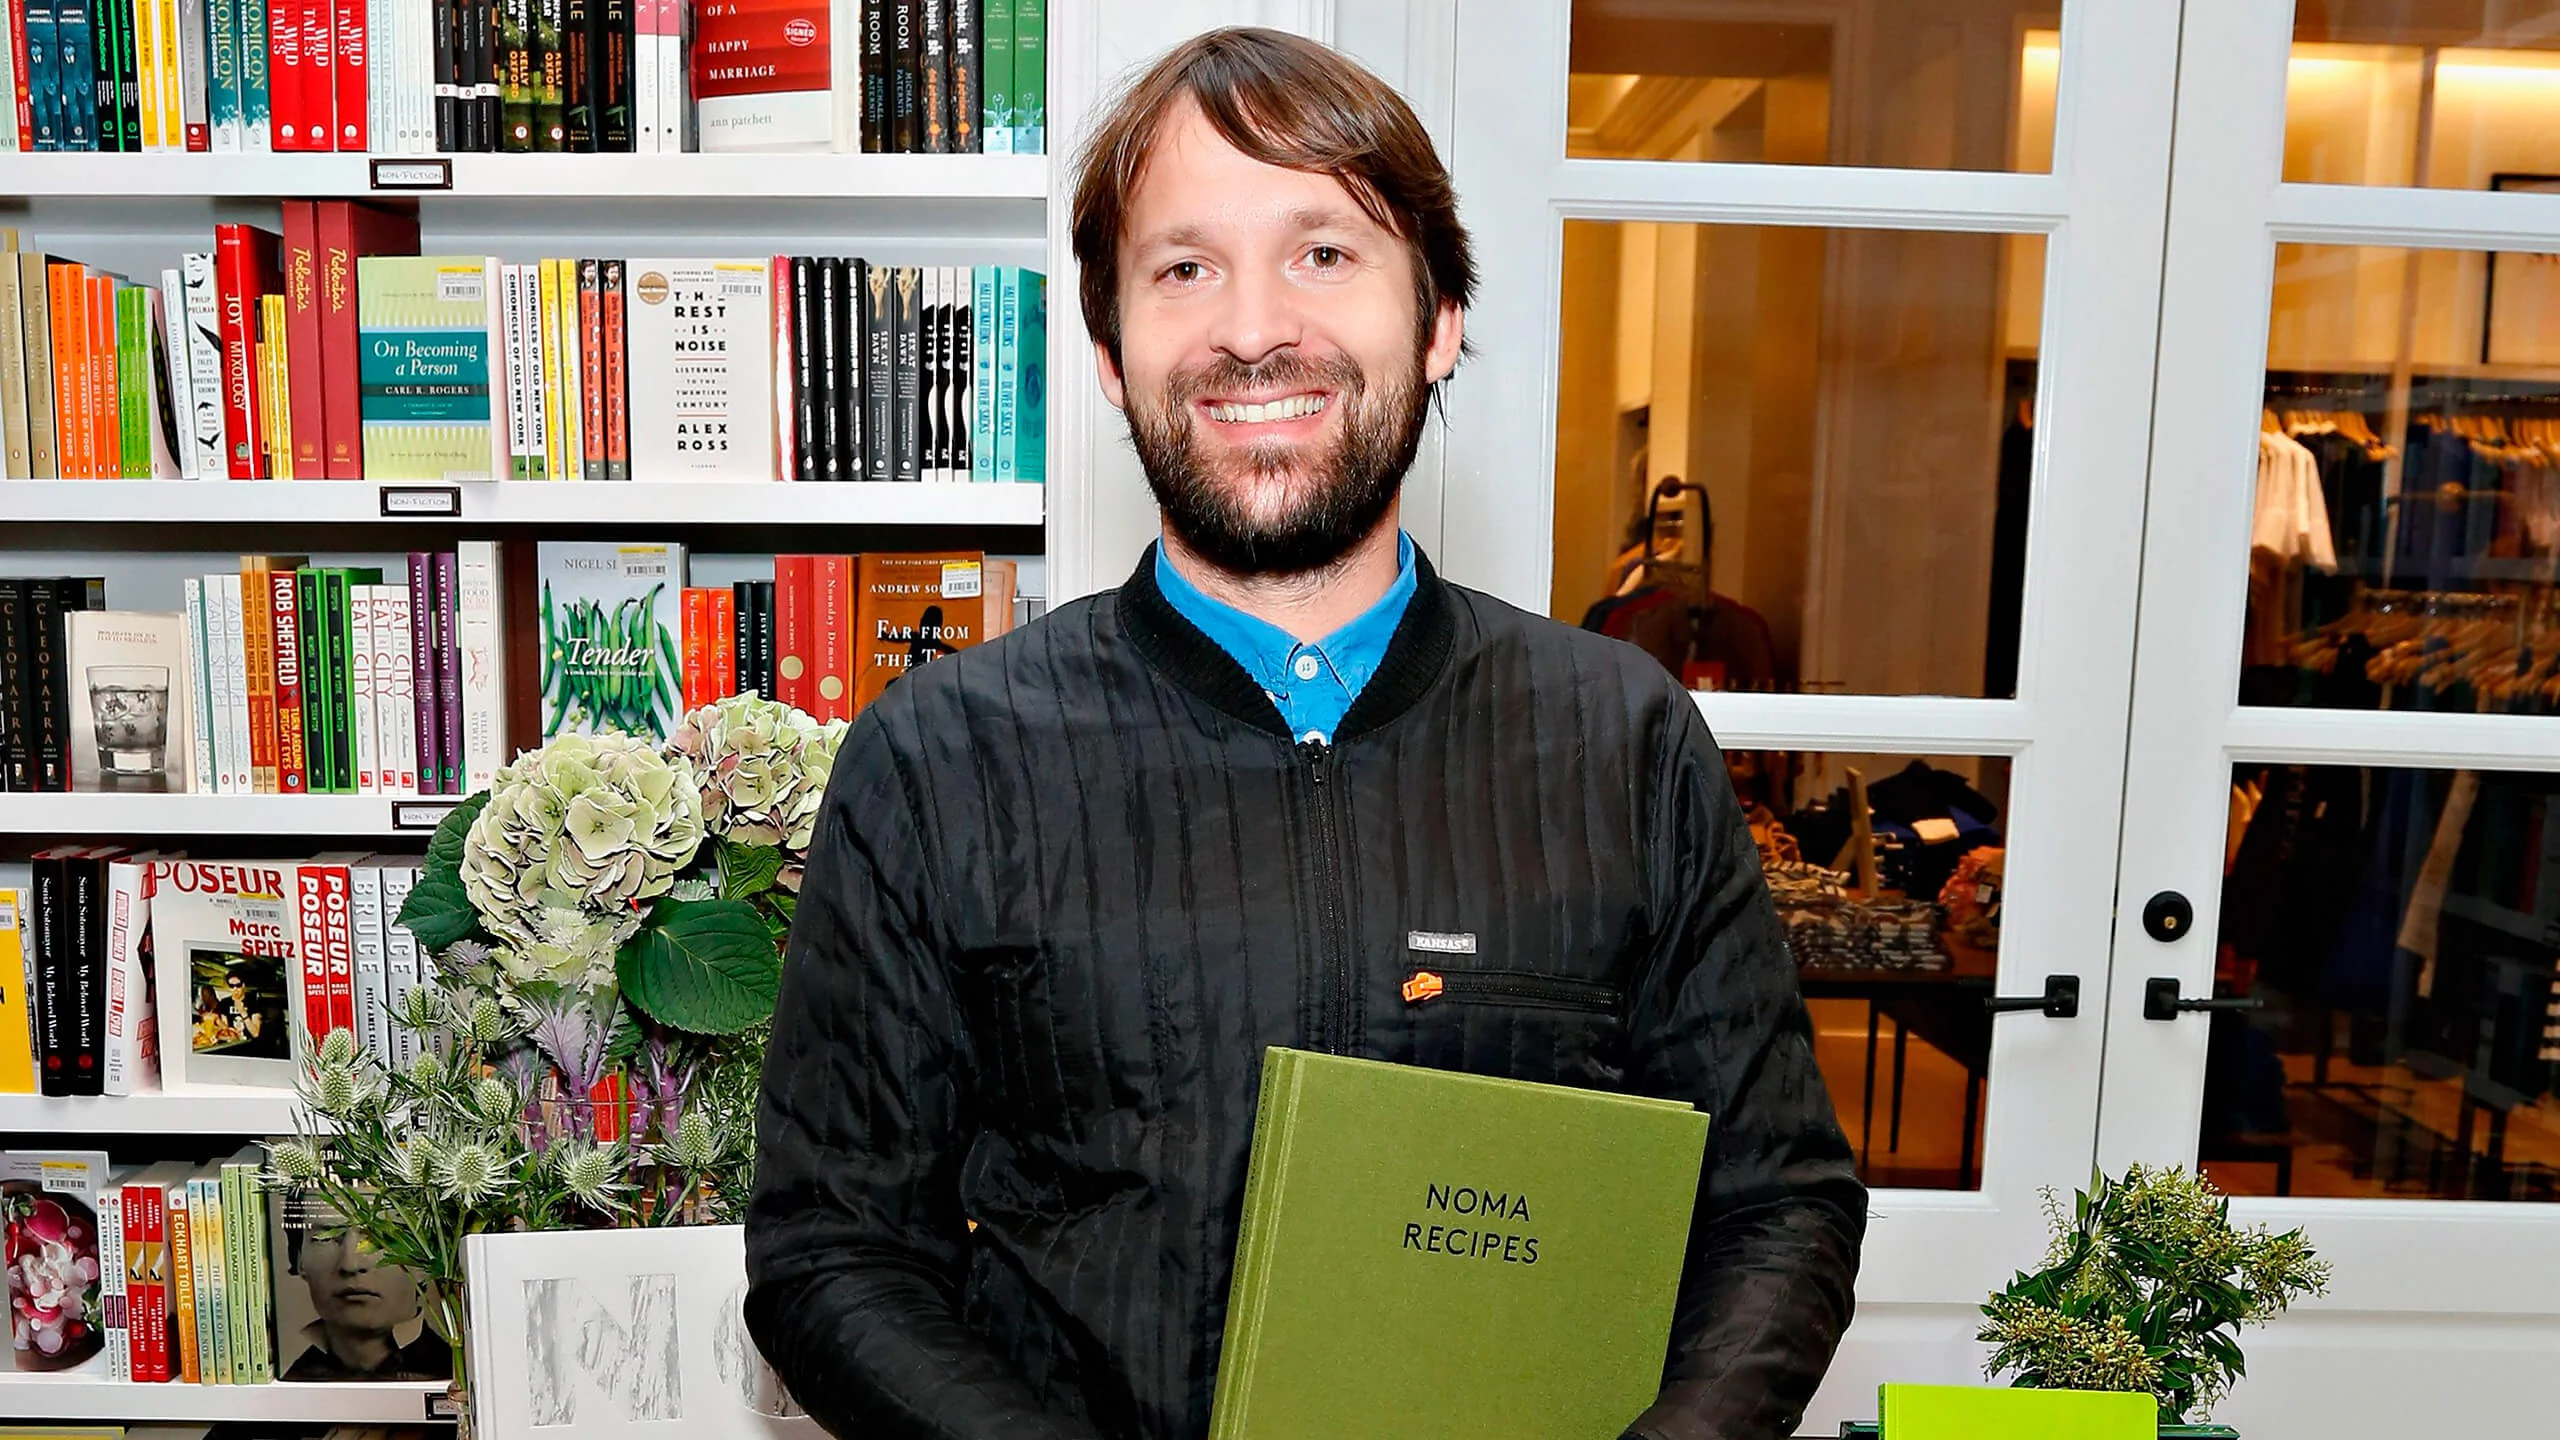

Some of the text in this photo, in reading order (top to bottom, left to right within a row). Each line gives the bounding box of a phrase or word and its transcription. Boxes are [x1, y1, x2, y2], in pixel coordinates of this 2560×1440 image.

[30, 8, 50, 16] JOSEPH
[707, 4, 736, 16] OF A
[897, 4, 908, 50] ROOM
[272, 8, 286, 56] TALES
[284, 26, 299, 66] WILD
[303, 8, 316, 56] TALES
[315, 26, 329, 66] WILD
[338, 8, 351, 56] TALES
[350, 26, 363, 66] WILD
[708, 40, 749, 53] HAPPY
[869, 10, 880, 55] ROOM
[510, 51, 519, 98] OXFORD
[520, 51, 528, 86] KELLY
[545, 52, 554, 100] OXFORD
[708, 64, 776, 80] MARRIAGE
[904, 72, 913, 115] MICHAEL
[710, 113, 772, 130] ann patchett
[293, 248, 312, 313] Roberta's
[329, 248, 348, 313] Roberta's
[225, 293, 242, 326] JOY
[508, 274, 519, 343] CHRONICLES
[514, 348, 520, 361] OF
[528, 274, 538, 343] CHRONICLES
[674, 306, 726, 318] REST
[980, 282, 992, 345] HALLUCINATIONS
[1002, 286, 1014, 346] HALLUCINATIONS
[675, 340, 726, 352] NOISE
[692, 325, 708, 334] IS
[871, 333, 880, 364] DAWN
[880, 330, 888, 366] SEX AT
[899, 334, 907, 365] DAWN
[908, 331, 916, 368] SEX AT
[374, 340, 478, 362] On Becoming
[396, 359, 458, 376] a Person
[532, 348, 539, 361] OF
[92, 354, 101, 416] FOOD RULES
[106, 354, 116, 416] FOOD RULES
[230, 340, 246, 410] MIXOLOGY
[385, 386, 470, 395] CARL R. ROGERS
[534, 388, 542, 413] NEW
[978, 379, 992, 434] OLIVER SACKS
[1000, 380, 1014, 436] OLIVER SACKS
[536, 416, 544, 446] YORK
[678, 424, 728, 434] ALEX
[678, 440, 728, 450] ROSS
[564, 558, 602, 569] NIGEL
[690, 594, 698, 606] The
[870, 584, 921, 593] ANDREW
[207, 598, 222, 644] ZADIE
[414, 566, 426, 670] VERY RECENT HISTORY
[440, 592, 448, 626] RECENT
[690, 610, 698, 640] Immortal
[826, 560, 838, 668] The Noonday Demon
[226, 596, 246, 707] ZADIE SMITH
[274, 578, 298, 686] ROB SHEFFIELD
[351, 600, 370, 700] EAT CITY
[372, 598, 392, 699] EAT CITY
[391, 600, 412, 700] EAT CITY
[441, 630, 449, 670] HISTORY
[566, 636, 655, 666] Tender
[688, 643, 700, 656] Life
[921, 626, 969, 640] FROM
[3, 602, 22, 745] CLEOPATRA
[36, 602, 54, 746] CLEOPATRA
[688, 659, 700, 667] of
[874, 648, 945, 667] THE T
[209, 654, 227, 707] SMITH
[279, 708, 290, 769] BRIGHT EYES
[290, 706, 302, 769] TURN AROUND
[471, 712, 480, 753] SITWELL
[480, 710, 488, 754] WILLIAM
[152, 863, 285, 900] POSEUR
[112, 890, 128, 961] WONDER WOMEN
[228, 918, 280, 938] Marc
[300, 875, 324, 976] POSEUR
[325, 874, 348, 976] POSEUR
[352, 880, 380, 975] BRUCE
[42, 876, 58, 1048] Sonia Sotomayor My Beloved World
[76, 876, 90, 1047] Sonia Sotomayor My Beloved World
[241, 938, 295, 958] SPITZ
[112, 969, 125, 1000] DEBORA
[109, 1014, 122, 1037] SPAR
[1426, 1183, 1530, 1222] NOMA
[173, 1214, 190, 1310] ECKHART TOLLE
[1402, 1222, 1540, 1265] RECIPES
